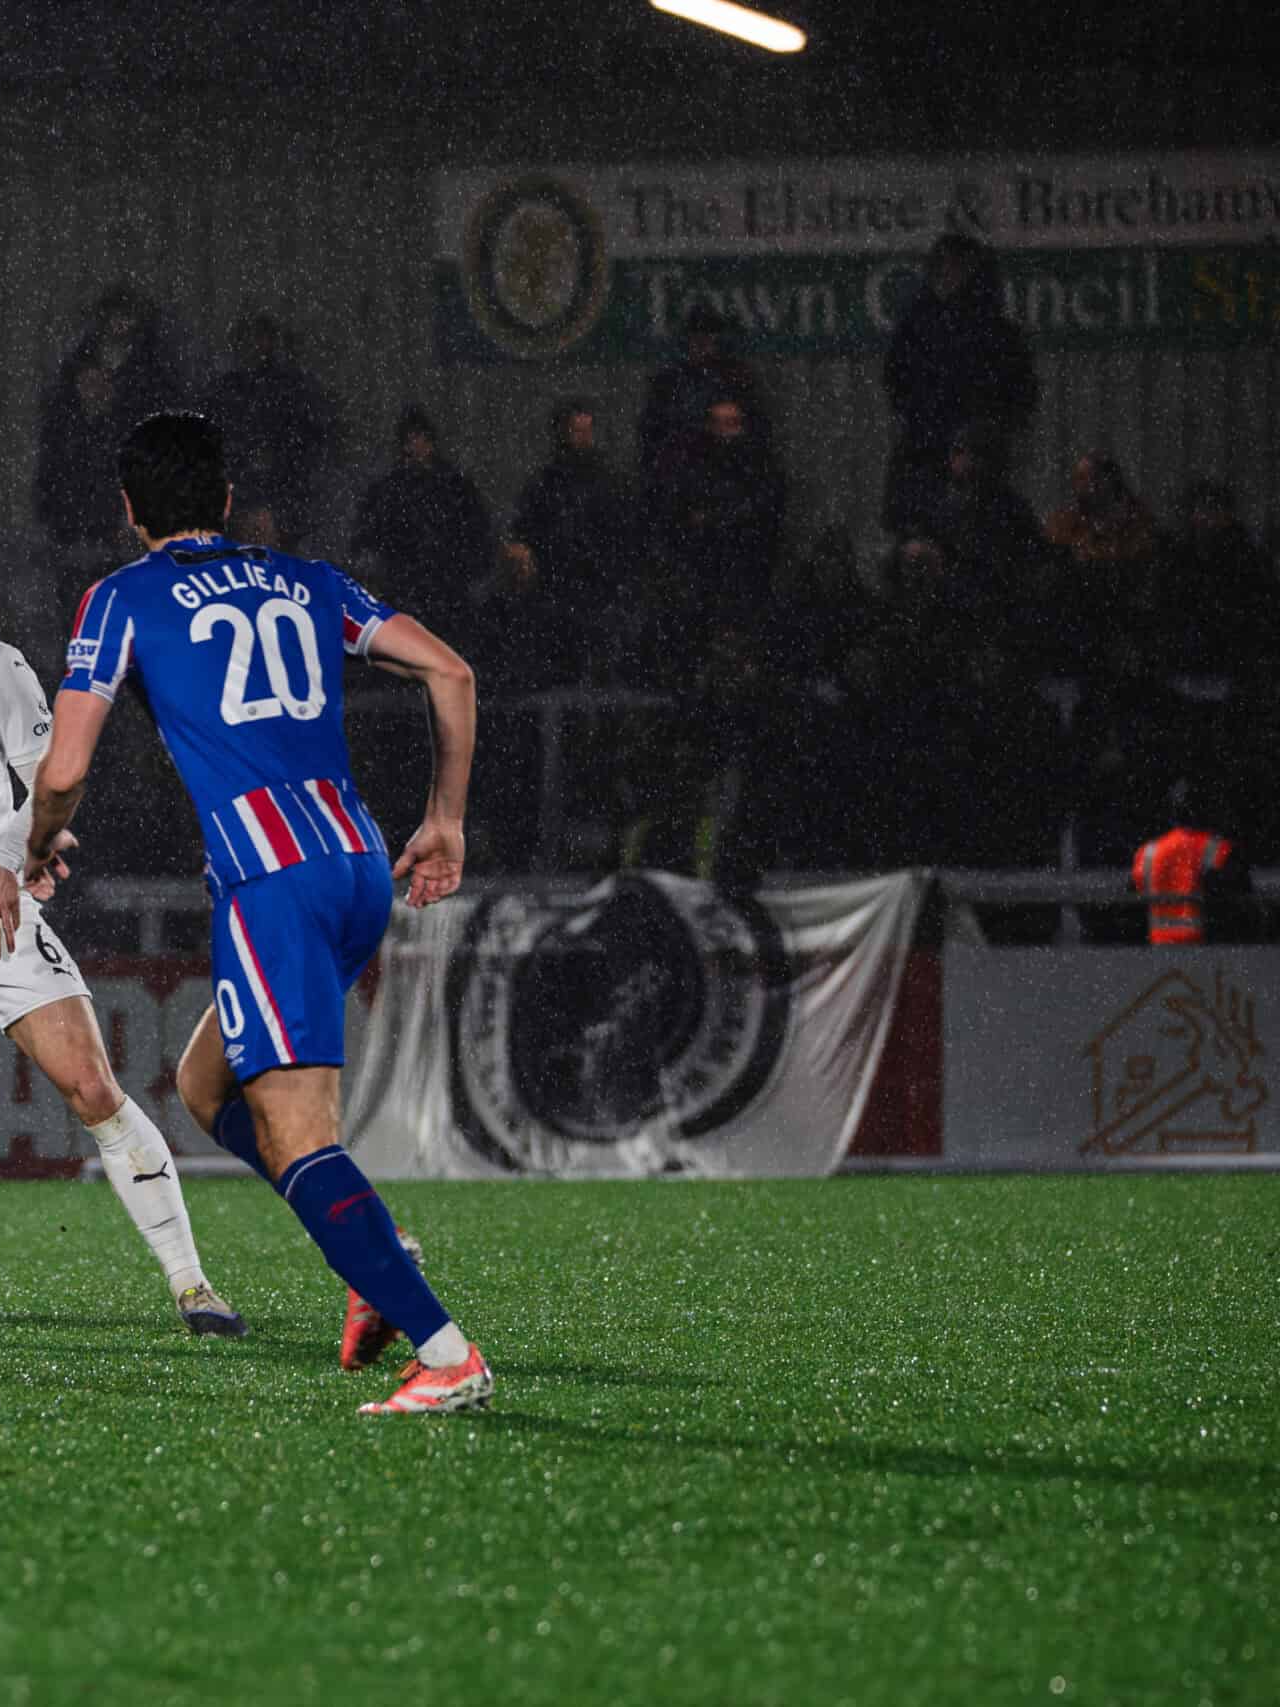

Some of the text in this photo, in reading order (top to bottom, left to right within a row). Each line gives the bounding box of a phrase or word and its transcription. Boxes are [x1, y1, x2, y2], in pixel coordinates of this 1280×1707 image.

[622, 180, 722, 237] The
[743, 180, 926, 237] Elstree
[943, 180, 990, 234] &
[171, 562, 311, 609] GILLIEAD
[189, 601, 327, 726] 20
[36, 924, 63, 964] 6
